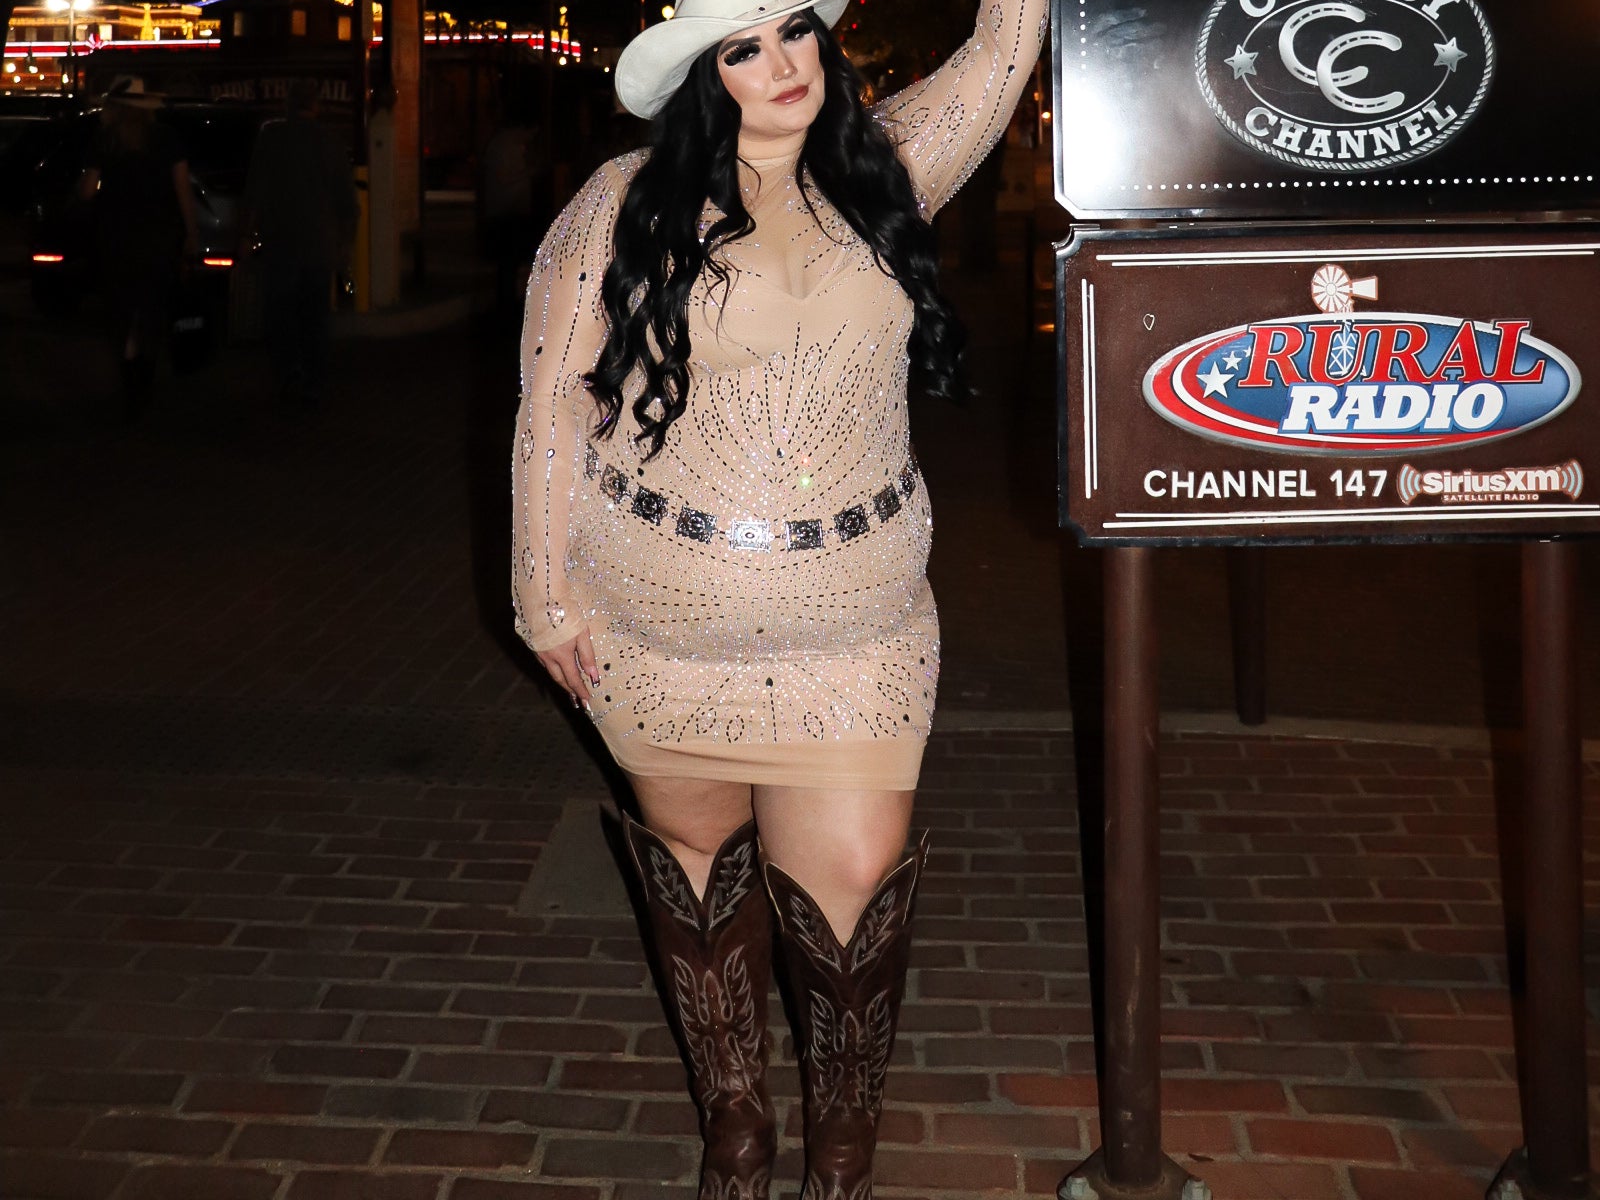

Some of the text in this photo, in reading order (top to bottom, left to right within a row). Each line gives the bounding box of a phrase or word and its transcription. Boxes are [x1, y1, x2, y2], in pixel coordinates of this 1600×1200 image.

[1245, 99, 1459, 161] CHANNEL
[1238, 320, 1547, 389] RURAL
[1283, 383, 1505, 432] RADIO
[1145, 470, 1316, 499] CHANNEL
[1330, 469, 1388, 497] 147
[1443, 493, 1539, 502] SATELLITE RADIO
